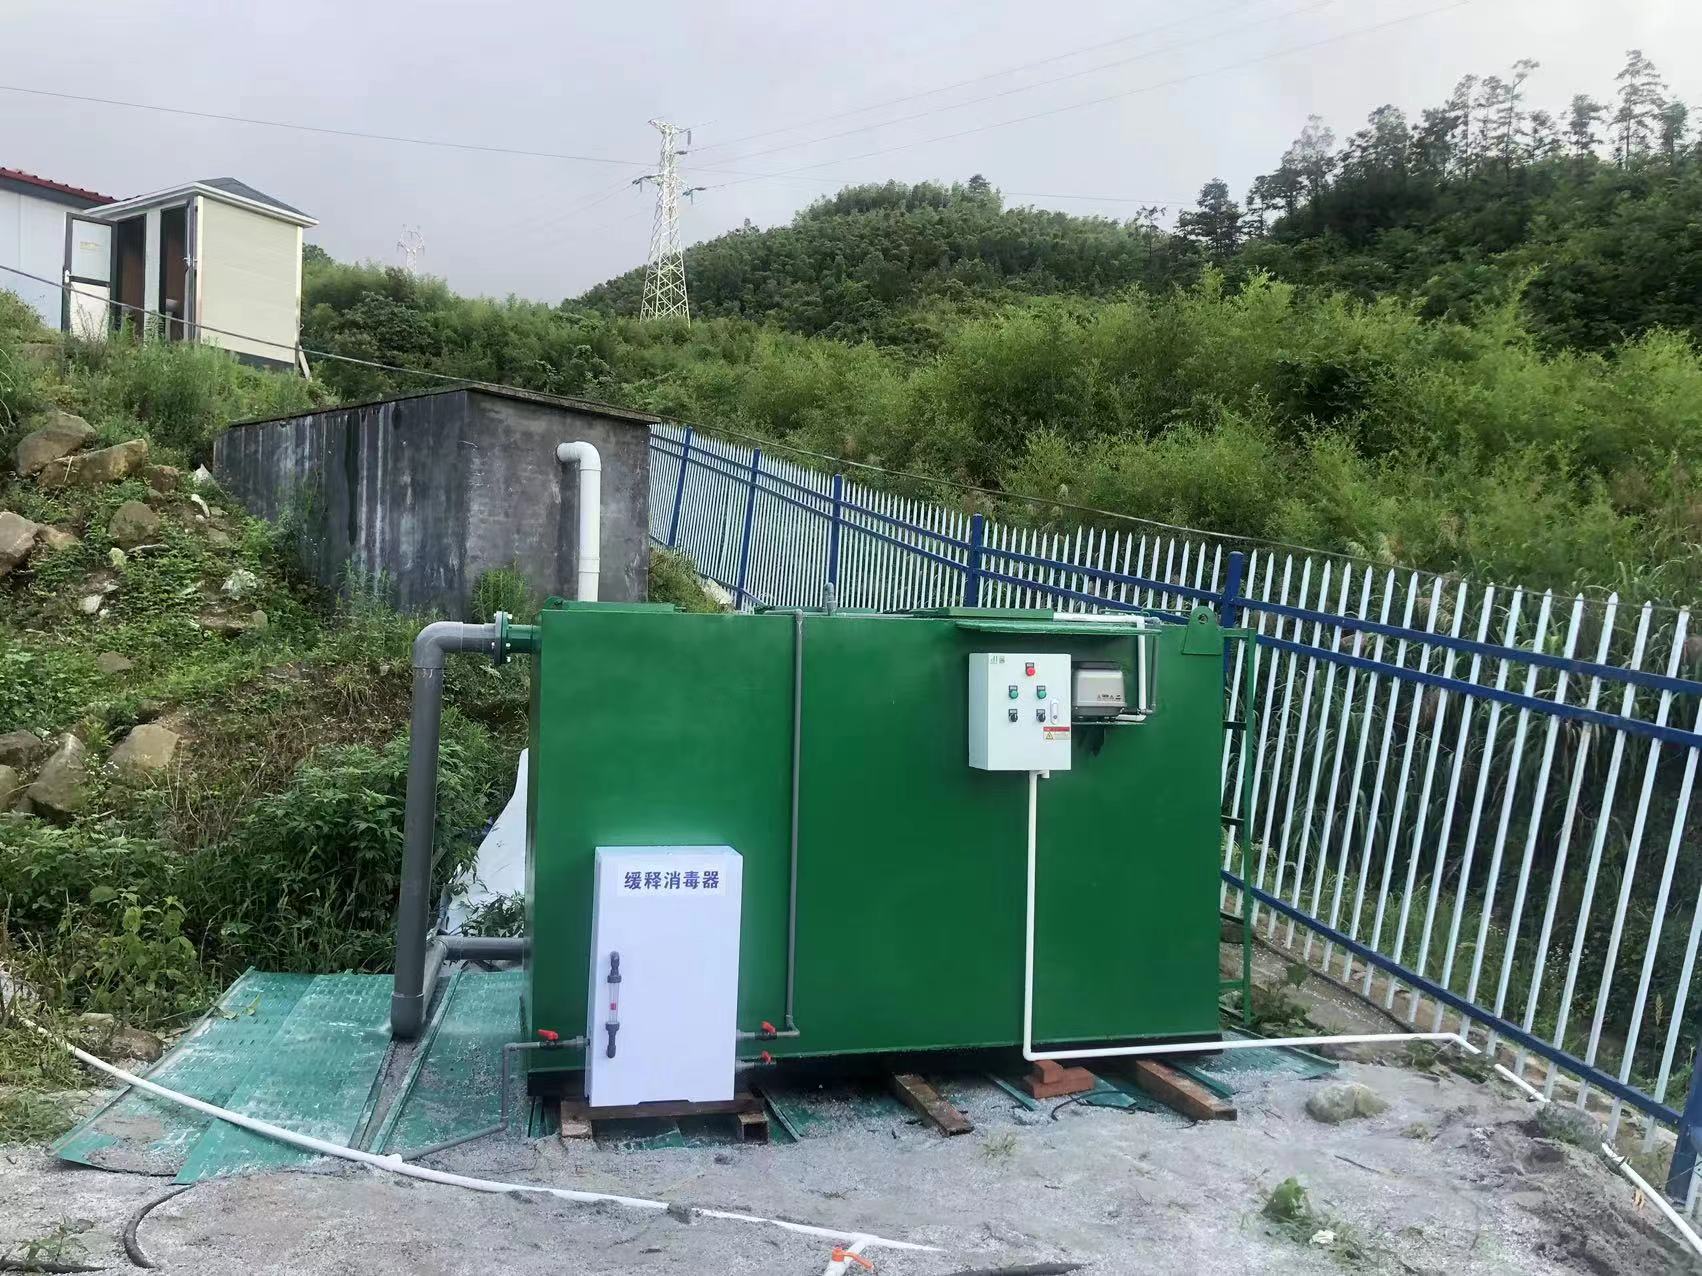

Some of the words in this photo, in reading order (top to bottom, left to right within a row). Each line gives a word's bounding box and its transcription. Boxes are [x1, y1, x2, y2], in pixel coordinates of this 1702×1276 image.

[624, 870, 720, 890] 缓释消毒器
